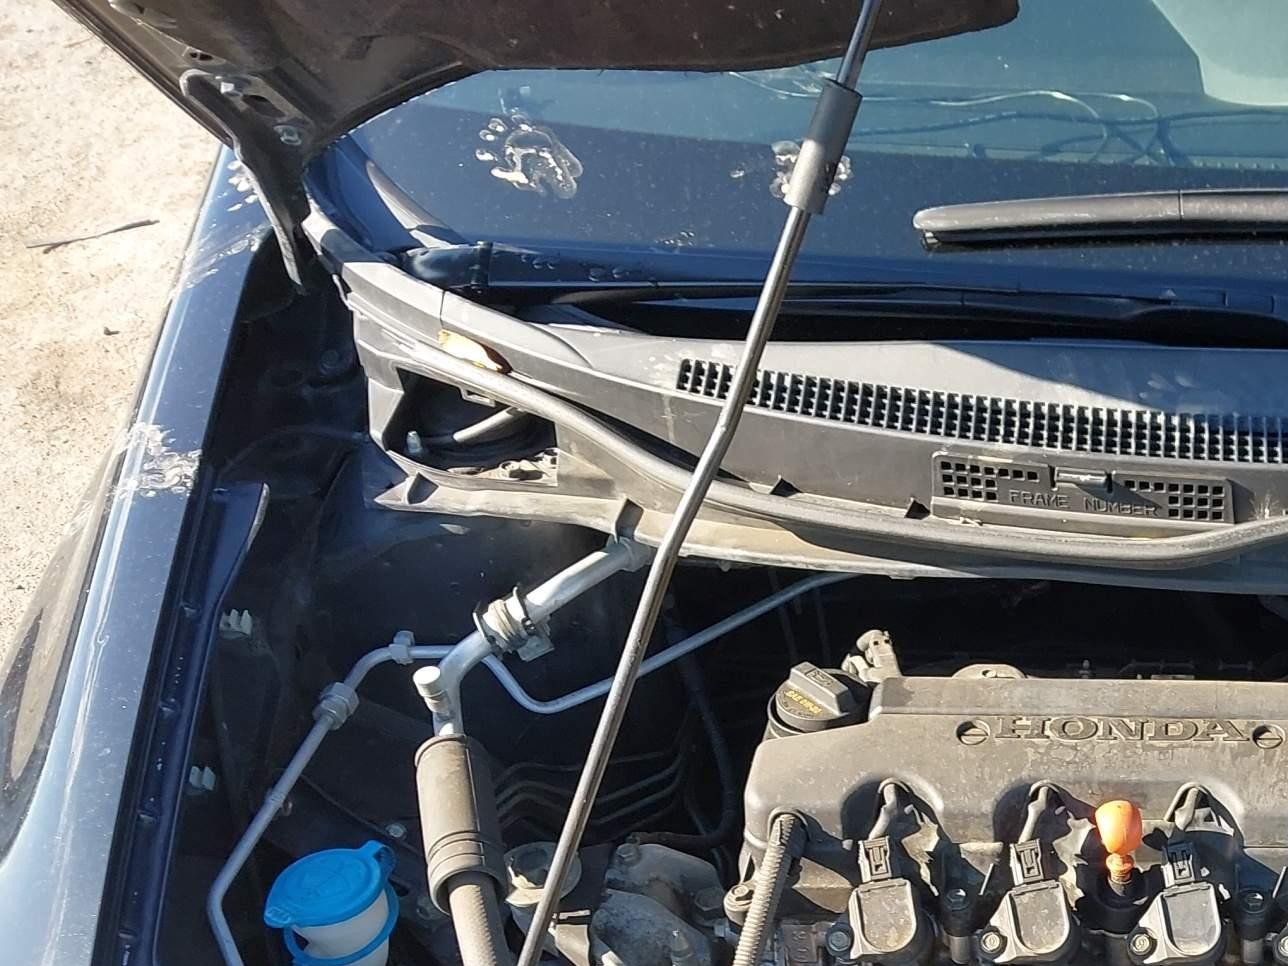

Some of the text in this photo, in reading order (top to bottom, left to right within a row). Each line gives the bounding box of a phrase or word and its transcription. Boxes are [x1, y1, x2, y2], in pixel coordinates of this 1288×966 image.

[1008, 488, 1160, 518] FRAME NUMBER
[994, 715, 1250, 742] HONDA
